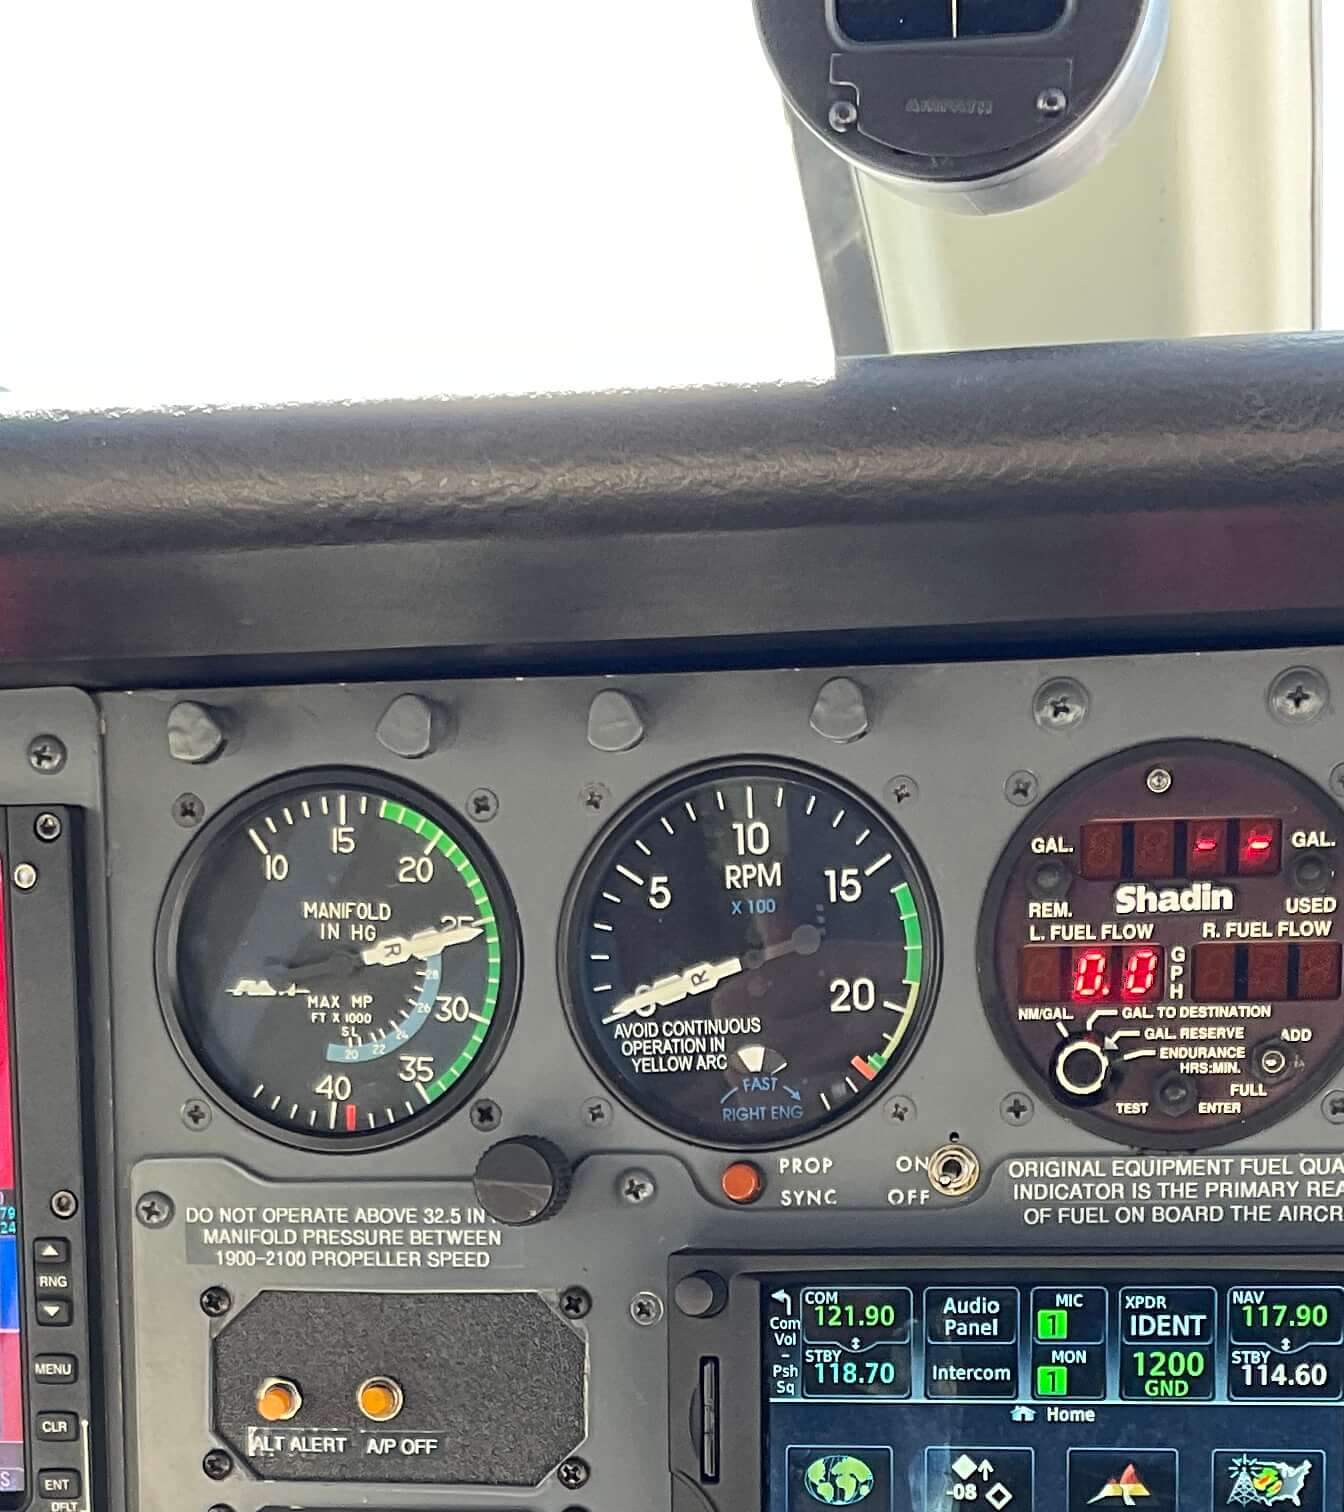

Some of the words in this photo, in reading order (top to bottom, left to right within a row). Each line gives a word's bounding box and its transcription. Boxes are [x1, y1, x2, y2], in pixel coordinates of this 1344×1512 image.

[725, 862, 782, 889] RPM
[1115, 883, 1234, 914] Shadin
[1286, 898, 1337, 913] USED
[304, 903, 391, 919] MANIFOLD
[320, 926, 339, 940] IN
[351, 925, 376, 941] HG
[1030, 925, 1046, 942] L.
[1050, 925, 1096, 941] FUEL
[1101, 923, 1153, 940] FLOW
[1203, 921, 1221, 939] R.
[1226, 921, 1272, 938] FUEL
[1278, 921, 1332, 937] FLOW
[614, 1022, 658, 1039] AVOID
[663, 1017, 761, 1036] CONTINUOUS
[621, 1039, 706, 1056] OPERATION
[710, 1038, 725, 1053] IN
[1159, 1046, 1245, 1059] ENDURANCE
[632, 1056, 692, 1073] YELLOW
[696, 1054, 727, 1071] ARC
[1116, 1102, 1148, 1114] TEST
[1198, 1102, 1241, 1114] ENTER
[779, 1158, 833, 1175] PROP
[1008, 1159, 1107, 1179] ORIGINAL
[1112, 1156, 1230, 1178] EQUIPMENT
[1238, 1156, 1295, 1176] FUEL
[780, 1188, 837, 1206] SYNC
[1013, 1180, 1127, 1200] INDICATOR
[1132, 1180, 1150, 1199] IS
[1155, 1180, 1194, 1199] THE
[1204, 1179, 1300, 1199] PRIMARY
[1024, 1206, 1052, 1225] OF
[1057, 1206, 1108, 1225] FUEL
[1114, 1206, 1146, 1224] ON
[1151, 1204, 1225, 1224] BOARD
[1230, 1204, 1271, 1224] THE
[203, 1230, 297, 1245] MANIFOLD
[303, 1230, 405, 1246] PRESSURE
[410, 1230, 502, 1246] BETWEEN
[216, 1251, 305, 1266] 1900-2100
[311, 1251, 421, 1267] PROPELLER
[427, 1251, 490, 1267] SPEED
[39, 1276, 67, 1288] RNG
[943, 1297, 1001, 1316] Audio
[814, 1305, 896, 1327] 121.90
[1243, 1305, 1328, 1328] 117.90
[944, 1317, 998, 1337] Panel
[1130, 1314, 1206, 1337] IDENT
[34, 1362, 72, 1377] MENU
[815, 1362, 896, 1385] 118.70
[932, 1364, 1011, 1382] Intercom
[1133, 1352, 1205, 1377] 1200
[1242, 1363, 1328, 1387] 114.60
[1046, 1407, 1096, 1424] Home
[42, 1419, 67, 1434] CLR
[45, 1478, 70, 1492] ENT
